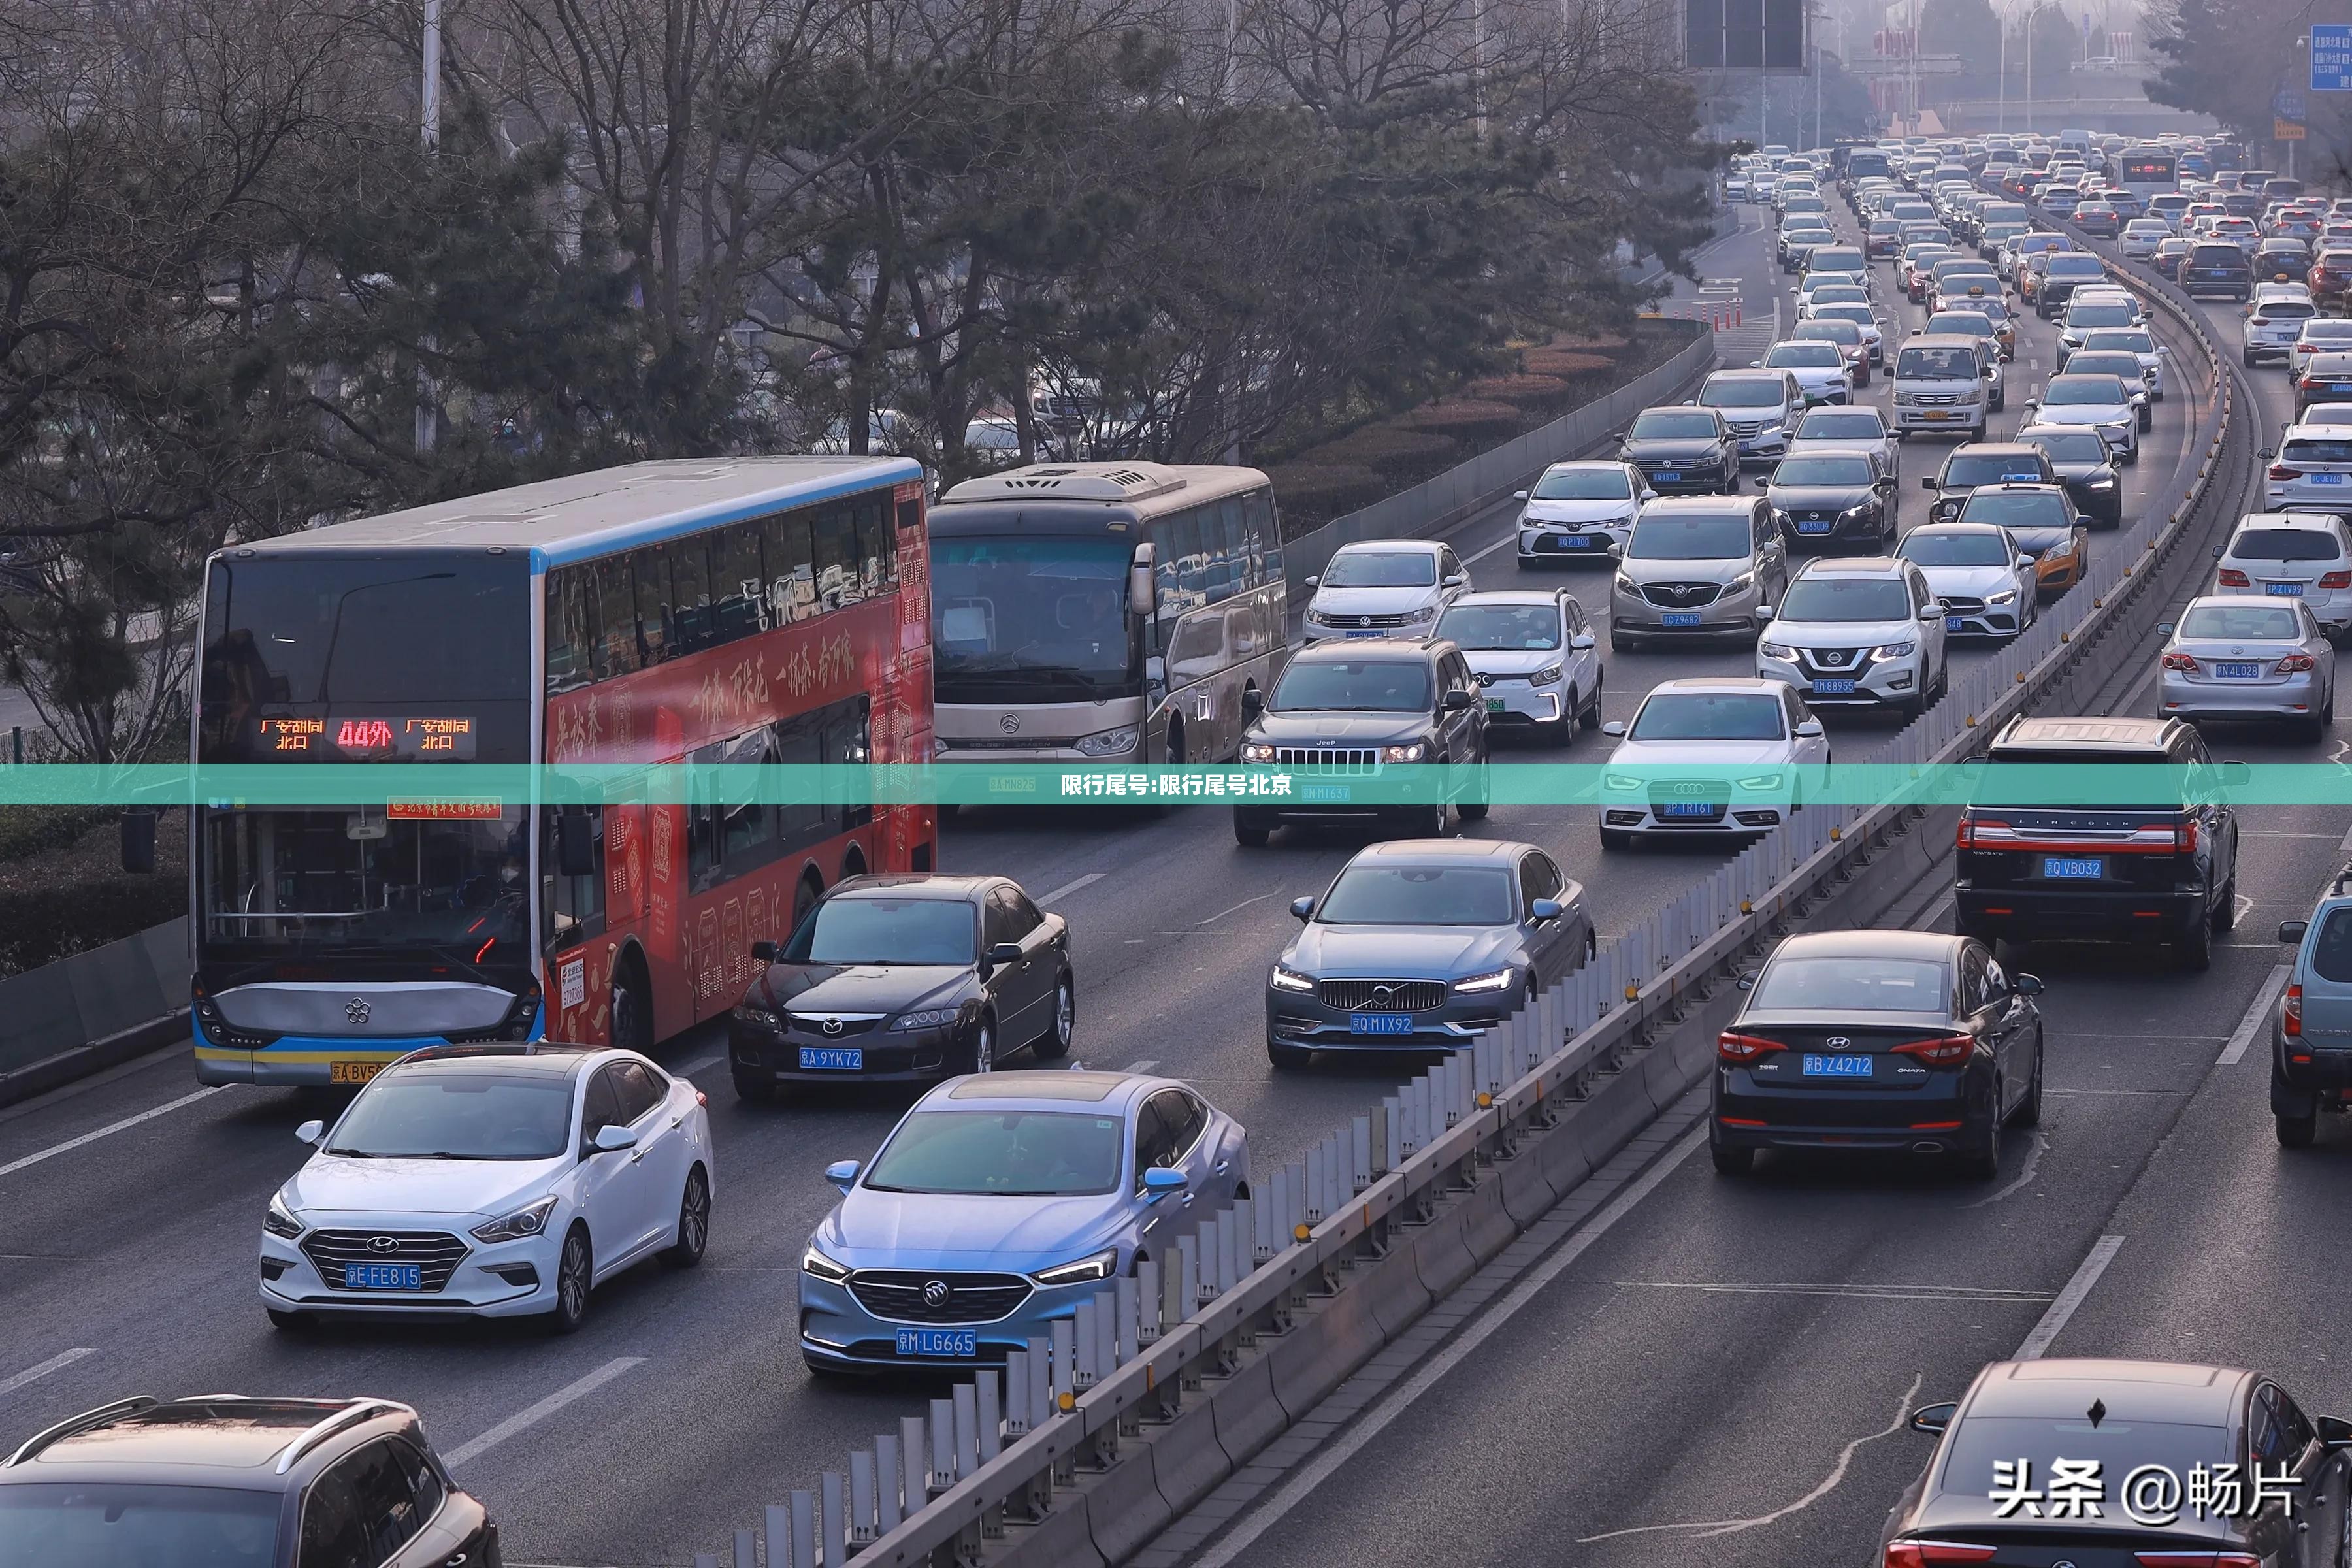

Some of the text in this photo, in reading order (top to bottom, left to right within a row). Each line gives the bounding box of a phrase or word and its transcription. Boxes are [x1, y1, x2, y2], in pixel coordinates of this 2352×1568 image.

[2340, 75, 2352, 88] 建
[276, 736, 306, 750] 北口
[421, 736, 452, 749] 北口
